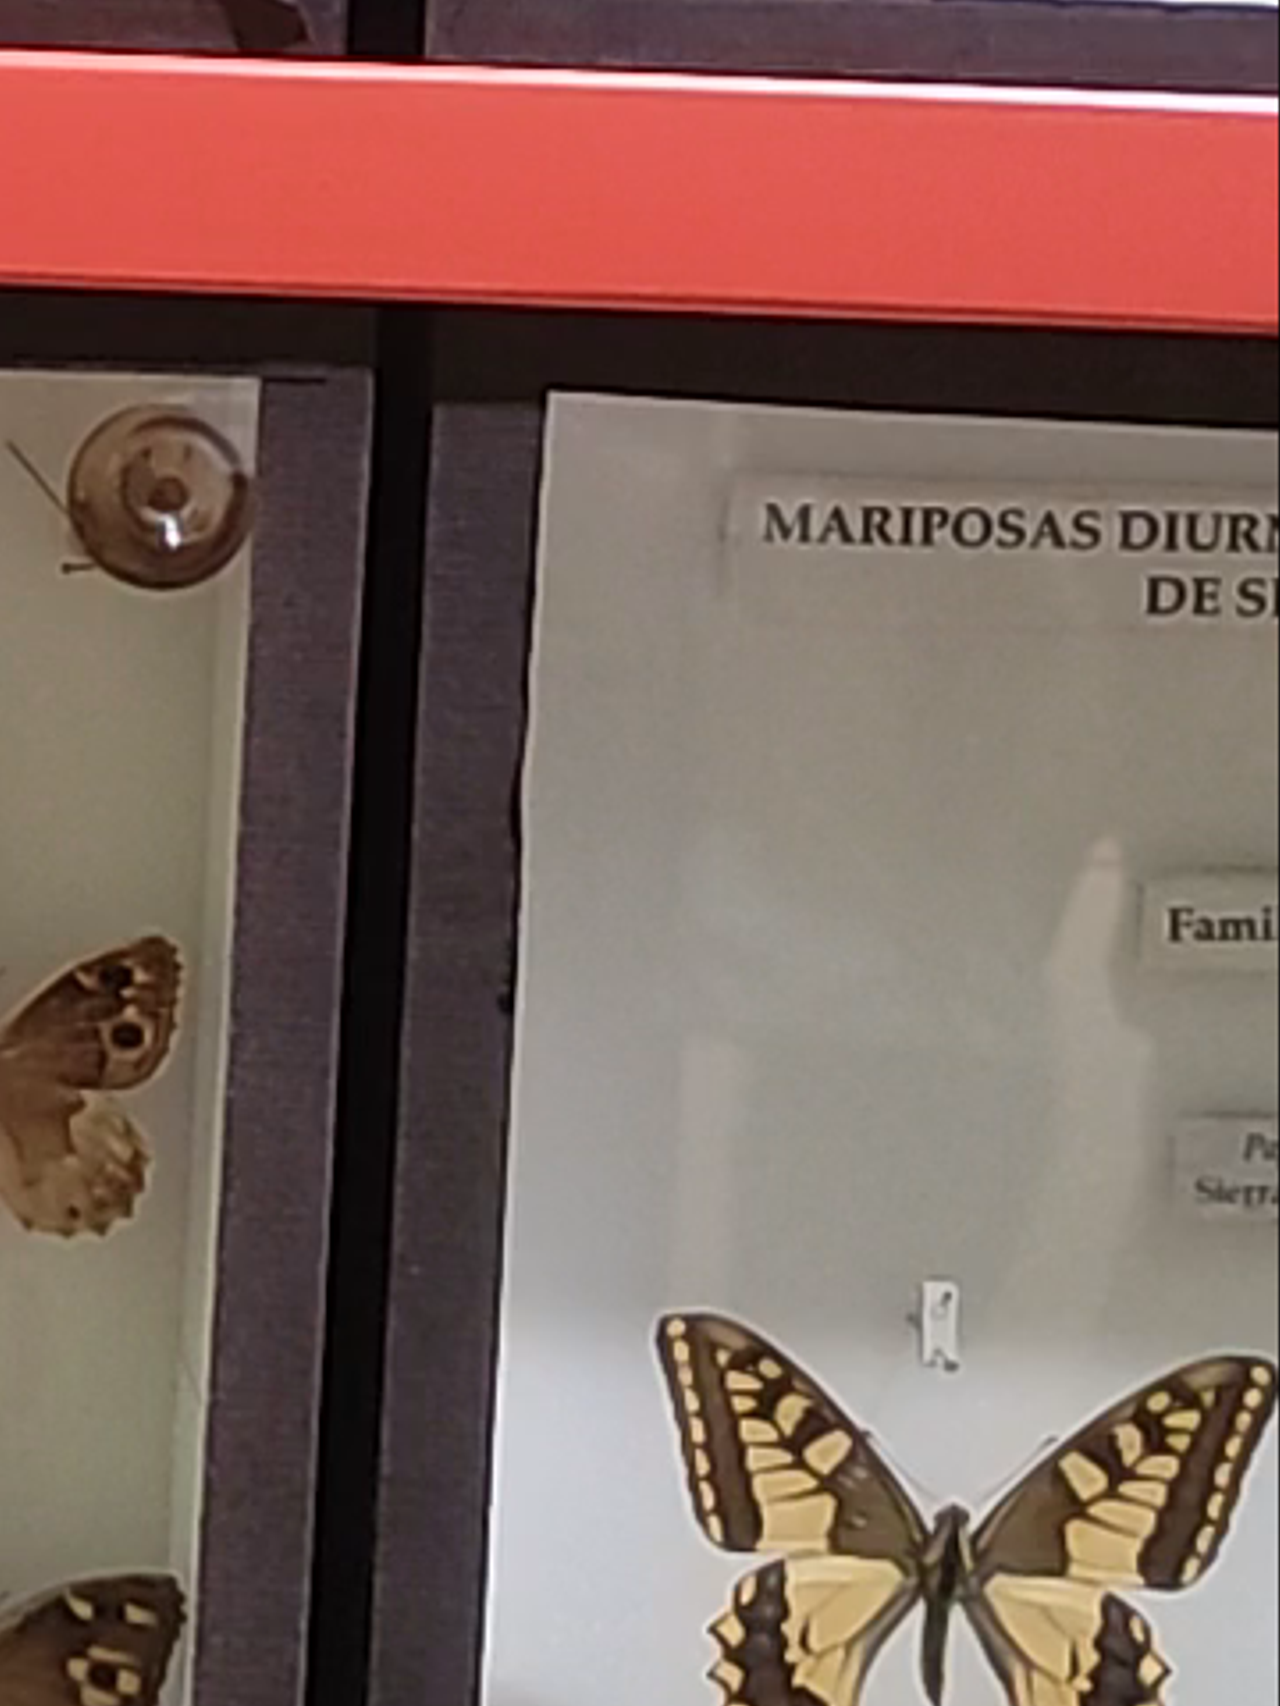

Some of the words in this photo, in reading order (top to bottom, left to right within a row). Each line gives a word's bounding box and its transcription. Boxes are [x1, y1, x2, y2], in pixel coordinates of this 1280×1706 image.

[764, 502, 1102, 552] MARIPOSAS
[1147, 576, 1222, 617] DE
[1167, 906, 1279, 945] Fami
